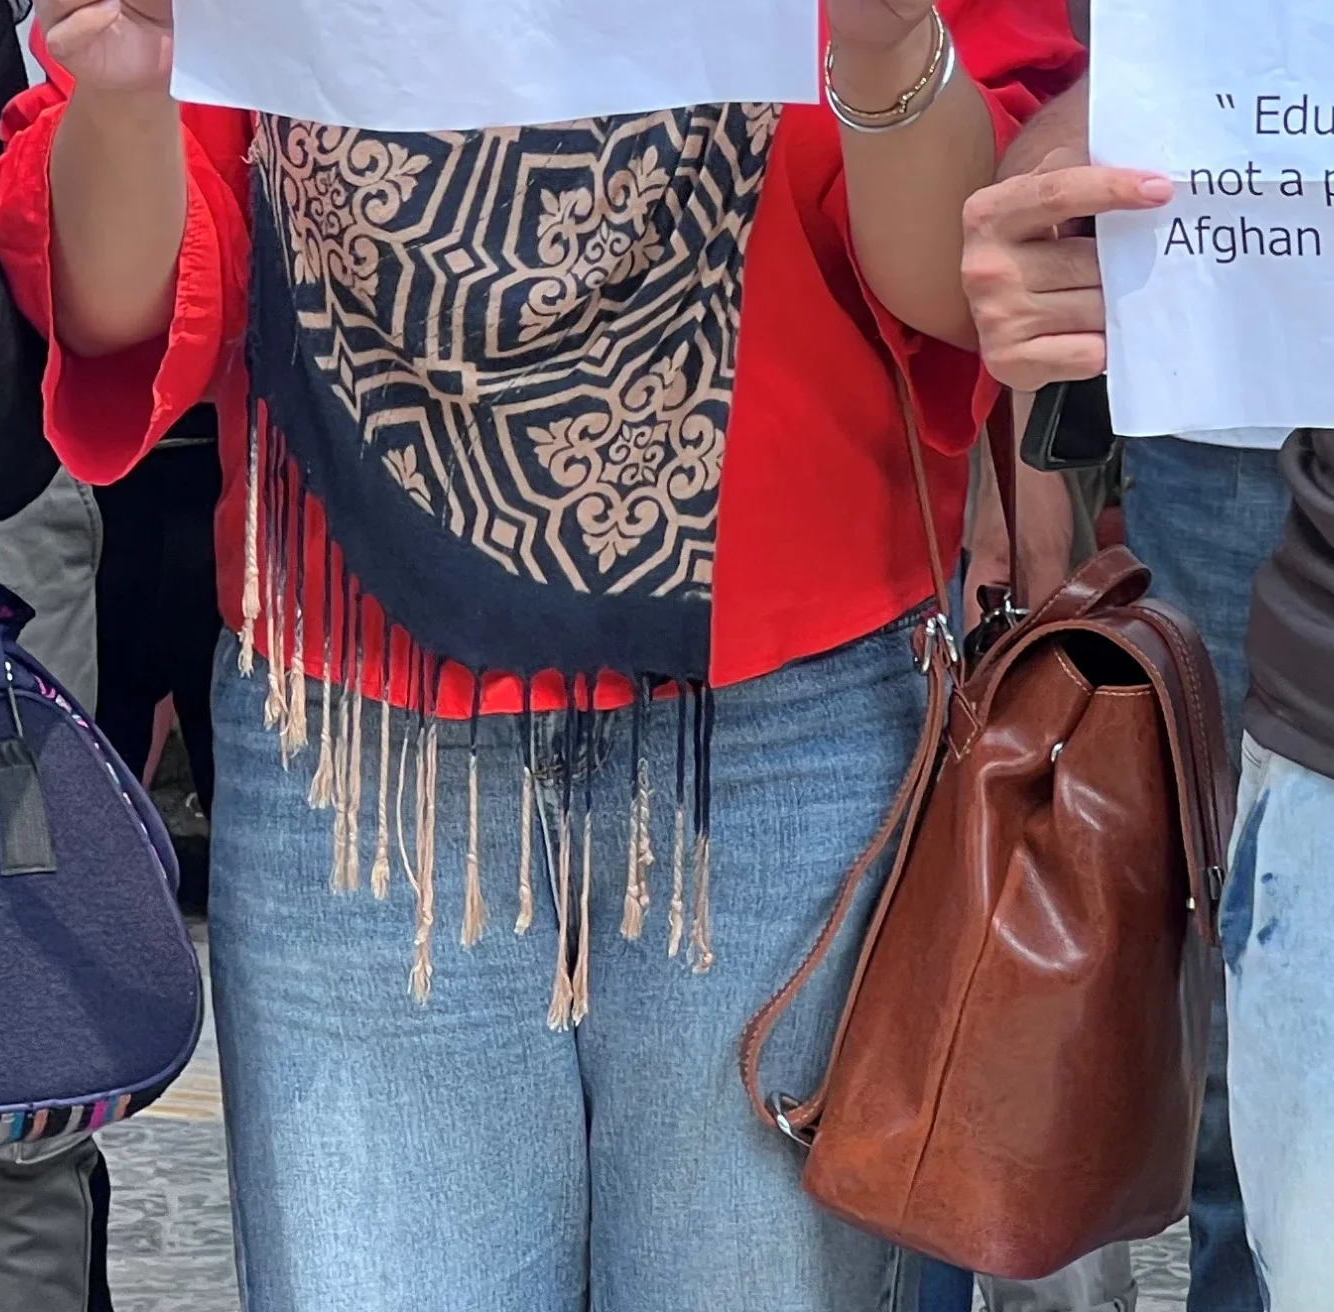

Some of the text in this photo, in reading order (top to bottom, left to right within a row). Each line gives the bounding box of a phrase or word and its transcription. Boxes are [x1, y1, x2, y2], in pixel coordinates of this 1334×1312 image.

[1189, 160, 1264, 197] not
[1279, 168, 1304, 198] a
[1163, 215, 1321, 265] Afghan
